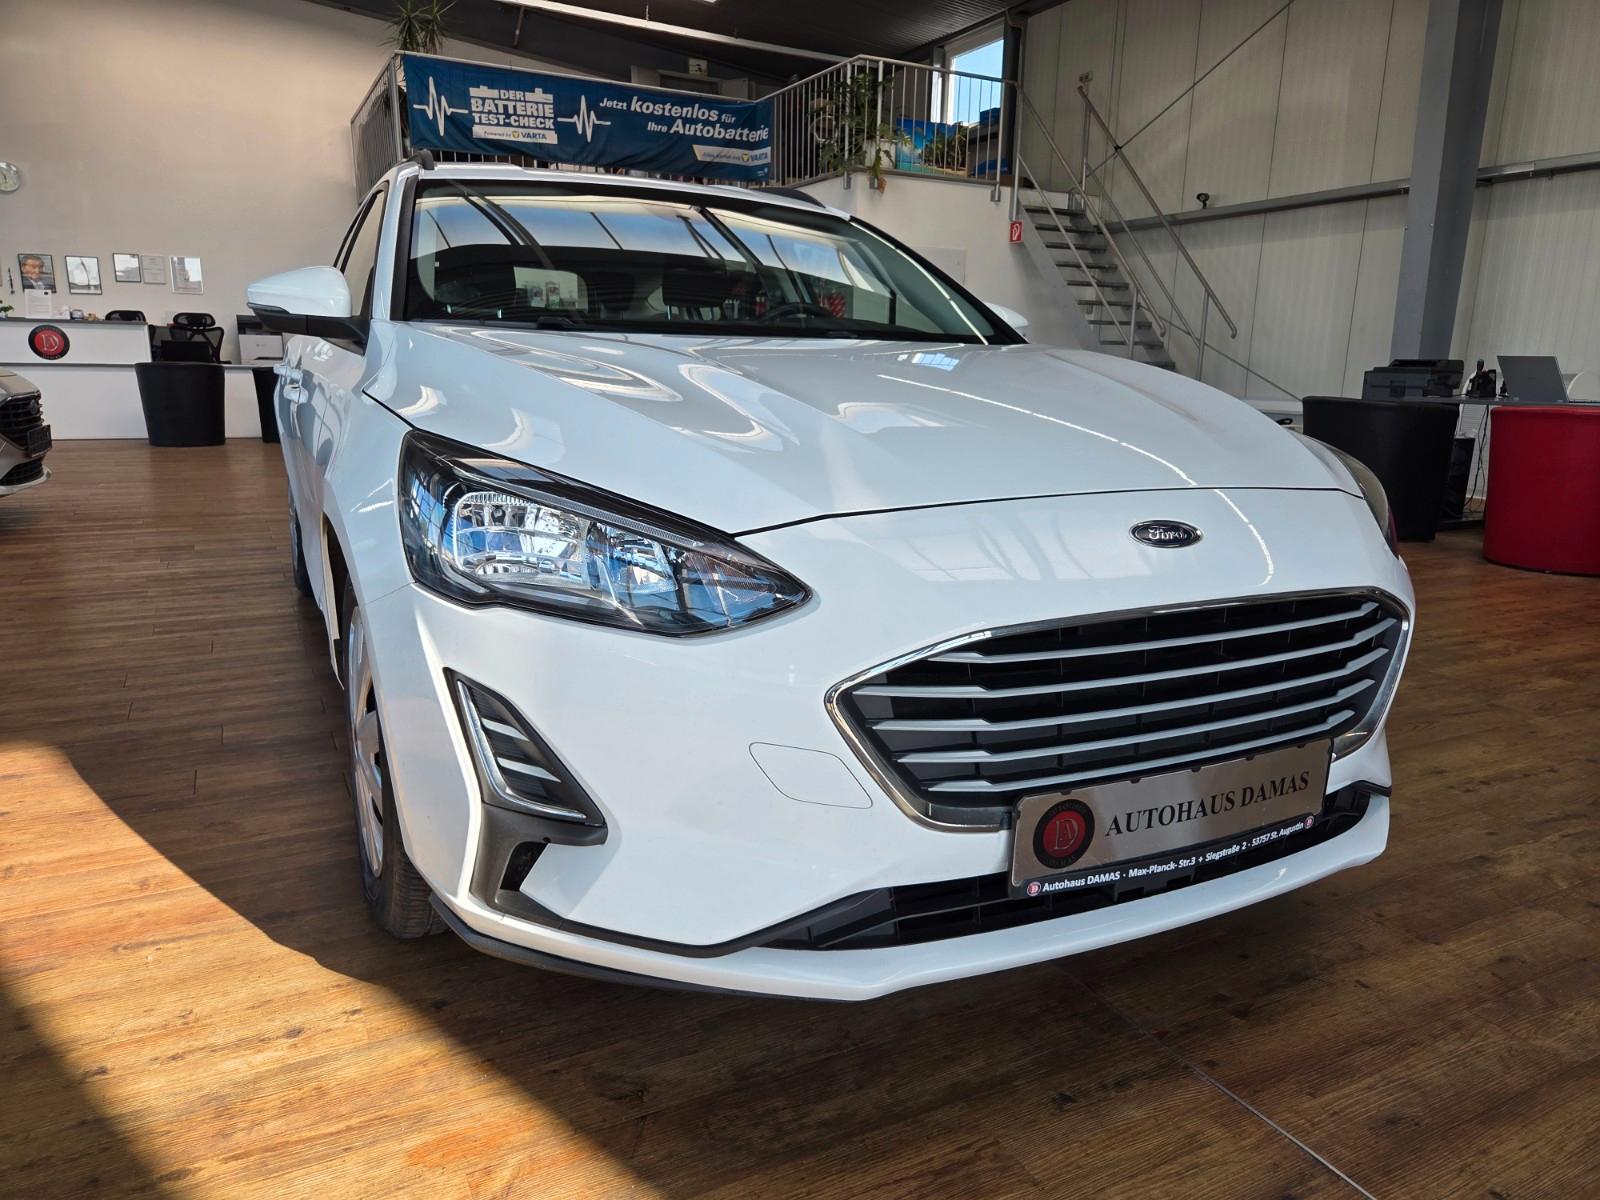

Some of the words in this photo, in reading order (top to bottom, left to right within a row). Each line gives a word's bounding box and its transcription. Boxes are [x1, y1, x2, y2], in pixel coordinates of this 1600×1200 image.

[500, 89, 524, 101] DER
[470, 97, 555, 118] BATTERIE
[599, 97, 628, 110] Jetzt
[630, 95, 720, 121] kostenlos
[721, 113, 737, 124] für
[472, 112, 555, 129] TEST-CHECK
[647, 121, 668, 133] Ihre
[669, 118, 769, 142] Autobatterie
[520, 132, 547, 140] VARTA
[1147, 527, 1188, 540] Ford
[1104, 790, 1236, 837] AUTOHAUS
[1240, 771, 1310, 808] DAMAS
[1042, 878, 1086, 892] Autohaus
[1087, 871, 1121, 885] DAMAS
[1205, 844, 1240, 862] Siegstraße
[1241, 841, 1247, 850] 2
[1252, 833, 1271, 847] 53757
[1270, 830, 1279, 840] St.
[1279, 821, 1304, 837] Augustin
